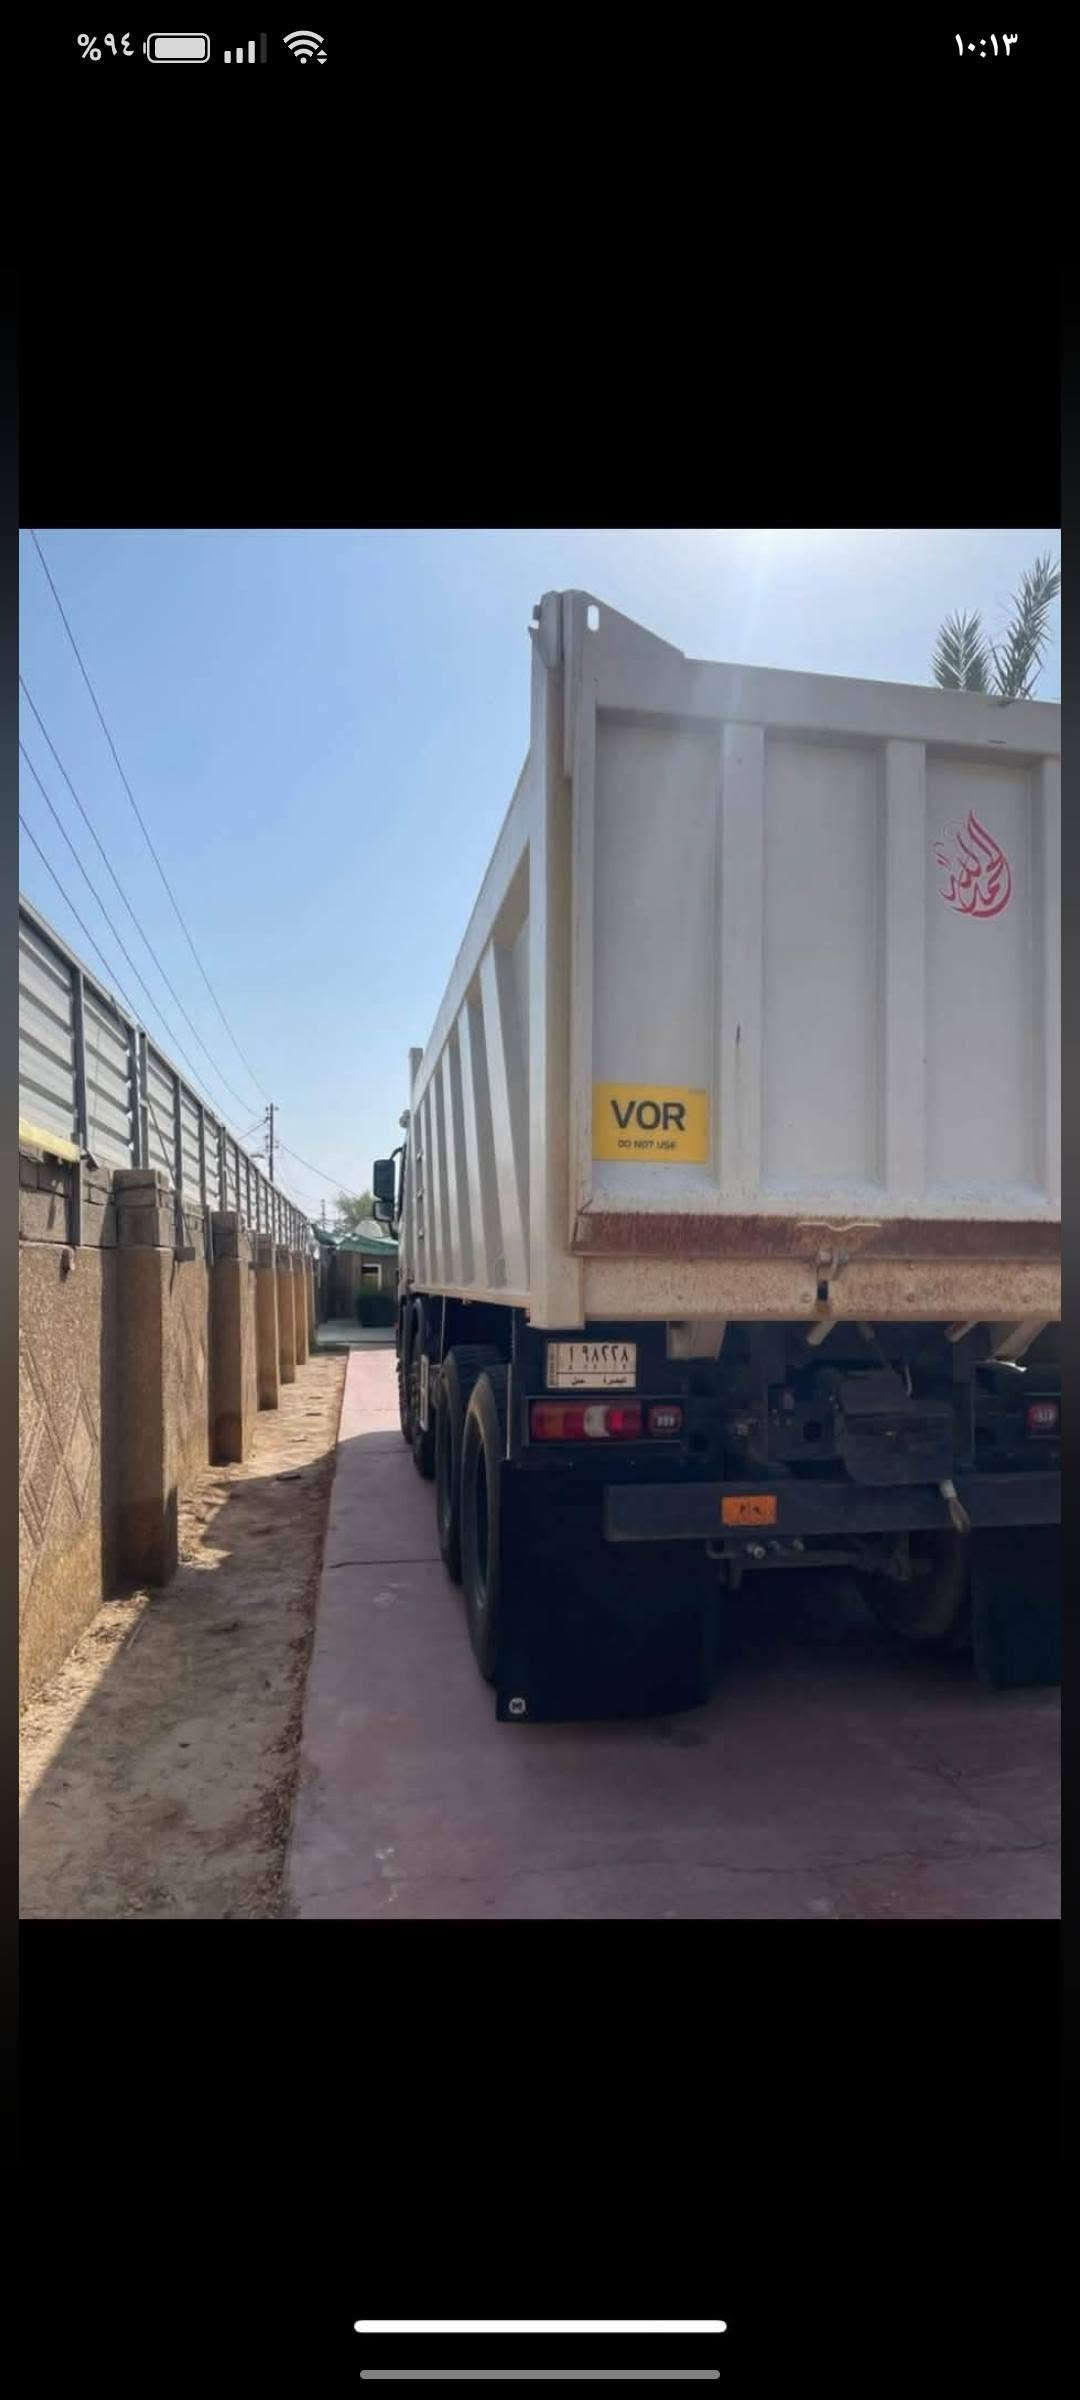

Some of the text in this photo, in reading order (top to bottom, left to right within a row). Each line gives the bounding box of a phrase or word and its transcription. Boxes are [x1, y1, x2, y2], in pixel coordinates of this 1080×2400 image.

[610, 1099, 686, 1131] VOR
[618, 1139, 677, 1151] DO NOT USE
